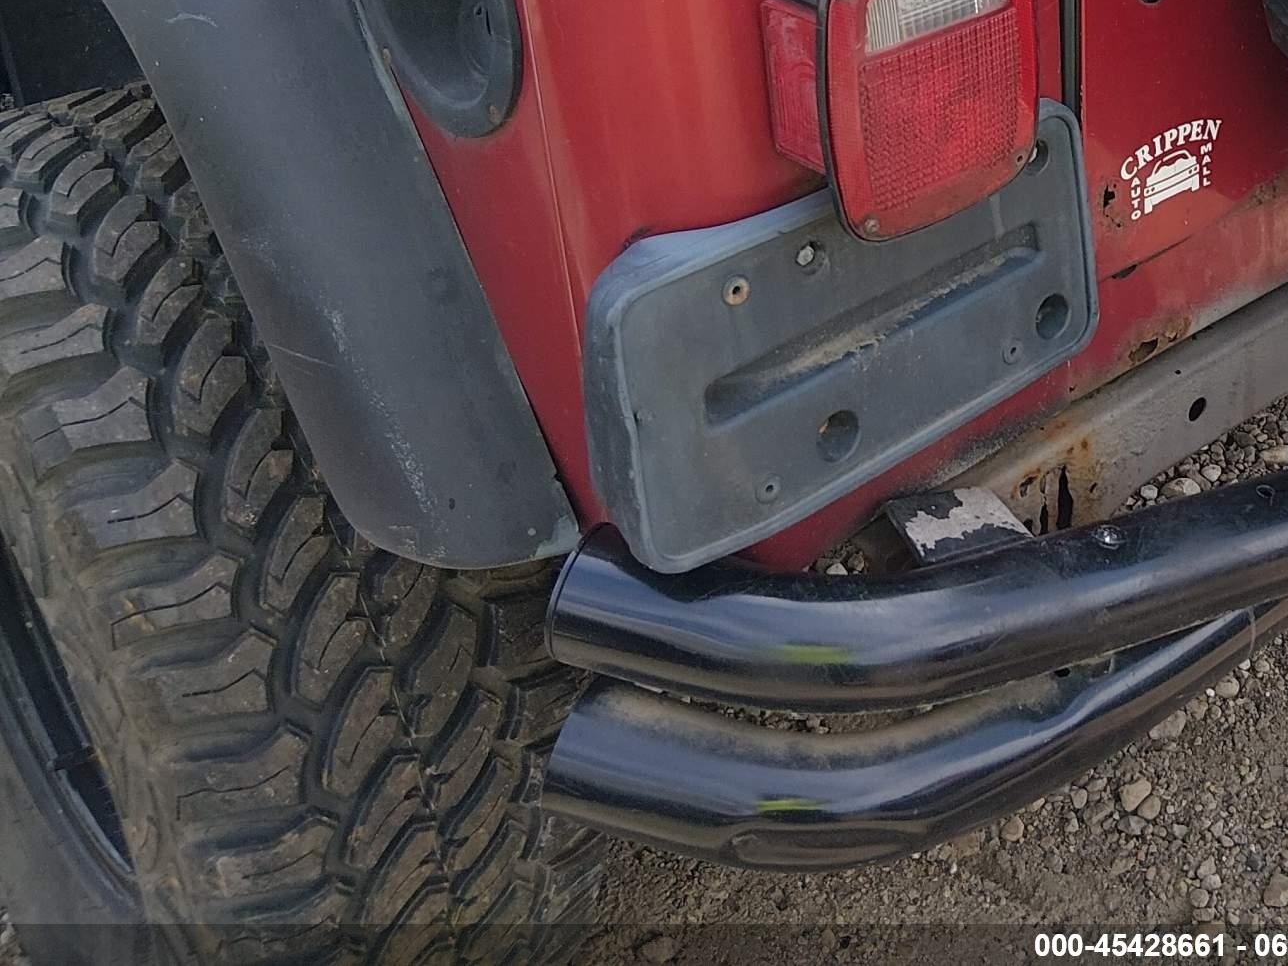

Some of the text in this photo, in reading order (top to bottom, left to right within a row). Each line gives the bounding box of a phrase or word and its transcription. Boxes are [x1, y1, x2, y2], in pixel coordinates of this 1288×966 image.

[1120, 119, 1222, 180] CRIPPEN
[1200, 142, 1213, 187] MALL
[1130, 175, 1142, 220] AUTO
